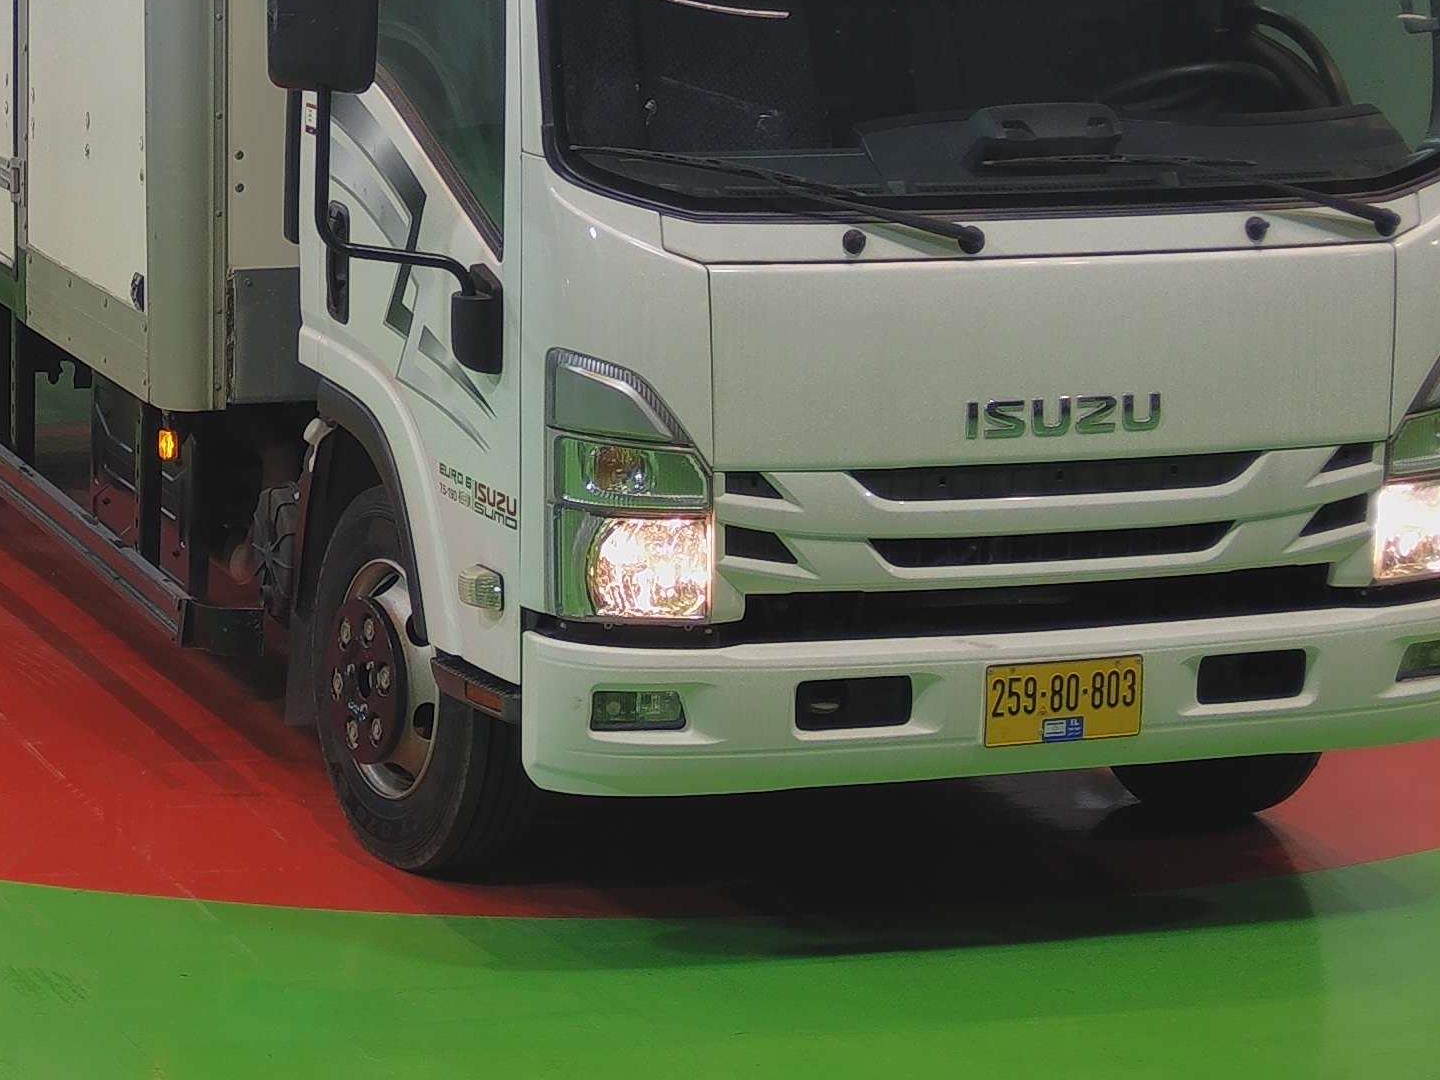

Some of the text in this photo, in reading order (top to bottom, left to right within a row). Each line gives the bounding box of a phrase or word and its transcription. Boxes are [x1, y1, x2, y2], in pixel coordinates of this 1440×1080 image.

[965, 391, 1161, 441] ISUZU
[439, 462, 463, 486] EURO
[474, 479, 517, 517] ISUZU
[474, 501, 518, 531] SUMO
